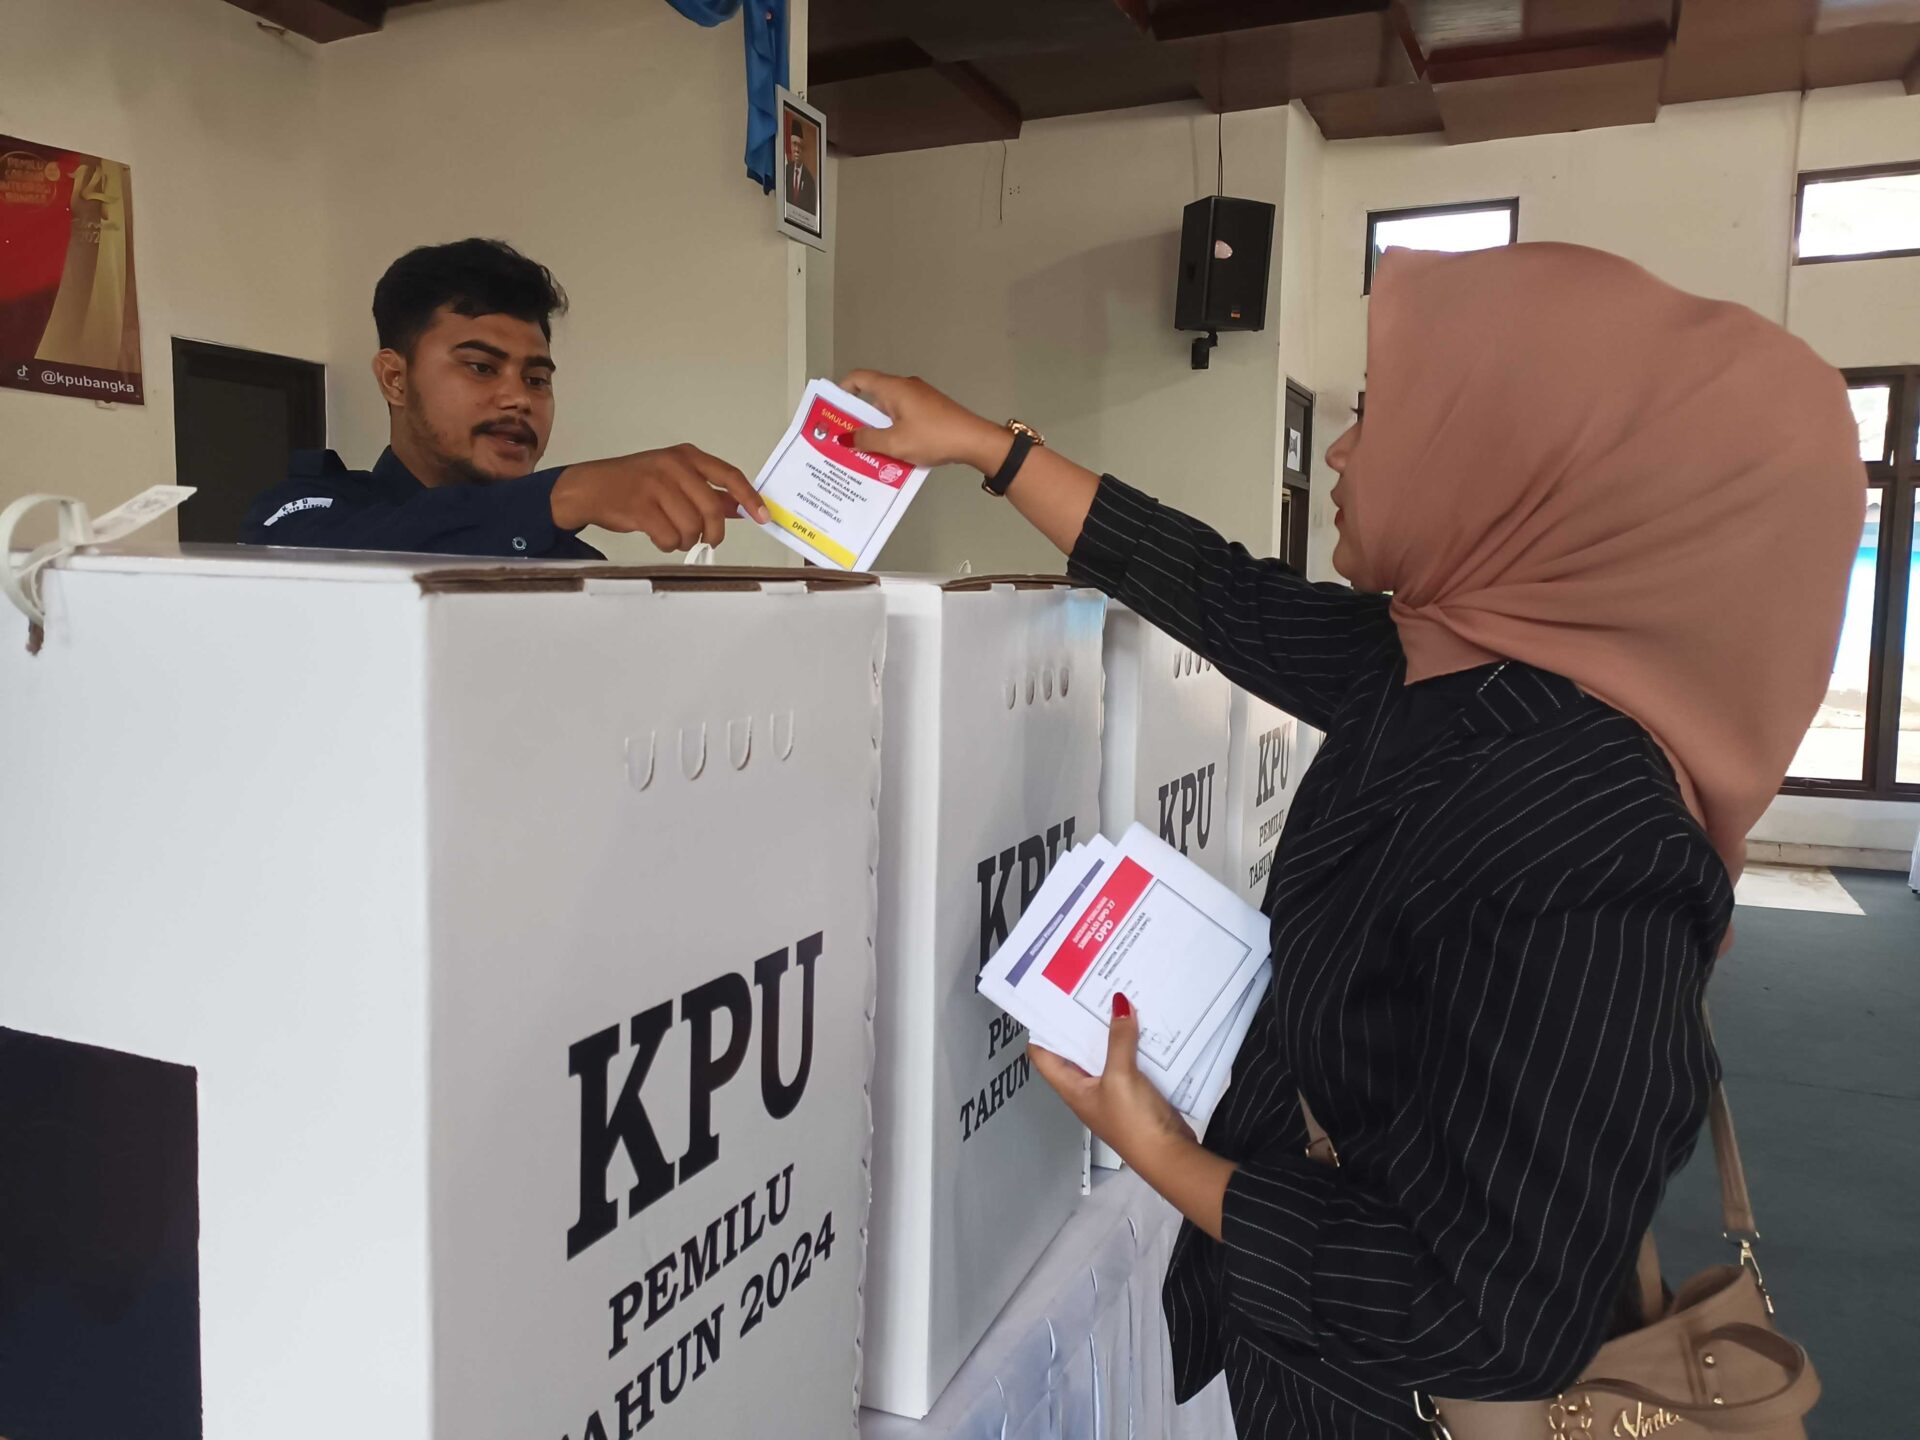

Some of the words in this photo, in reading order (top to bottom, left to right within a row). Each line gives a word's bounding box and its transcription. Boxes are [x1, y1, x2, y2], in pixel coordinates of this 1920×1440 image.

[41, 370, 135, 393] @kpubangka
[820, 407, 854, 432] SIMULASI
[855, 449, 881, 469] SUARA
[792, 521, 808, 534] DPR
[807, 531, 816, 540] RI
[1256, 721, 1292, 807] KPU
[1158, 762, 1215, 857] KPU
[1259, 810, 1284, 847] PEMILU
[1249, 850, 1273, 889] TAHUN
[975, 816, 1076, 994] KP
[1094, 918, 1115, 943] DPD
[567, 930, 823, 1261] KPU
[608, 1163, 794, 1360] PEMILU
[558, 1303, 724, 1440] HUN
[740, 1211, 835, 1339] 2024
